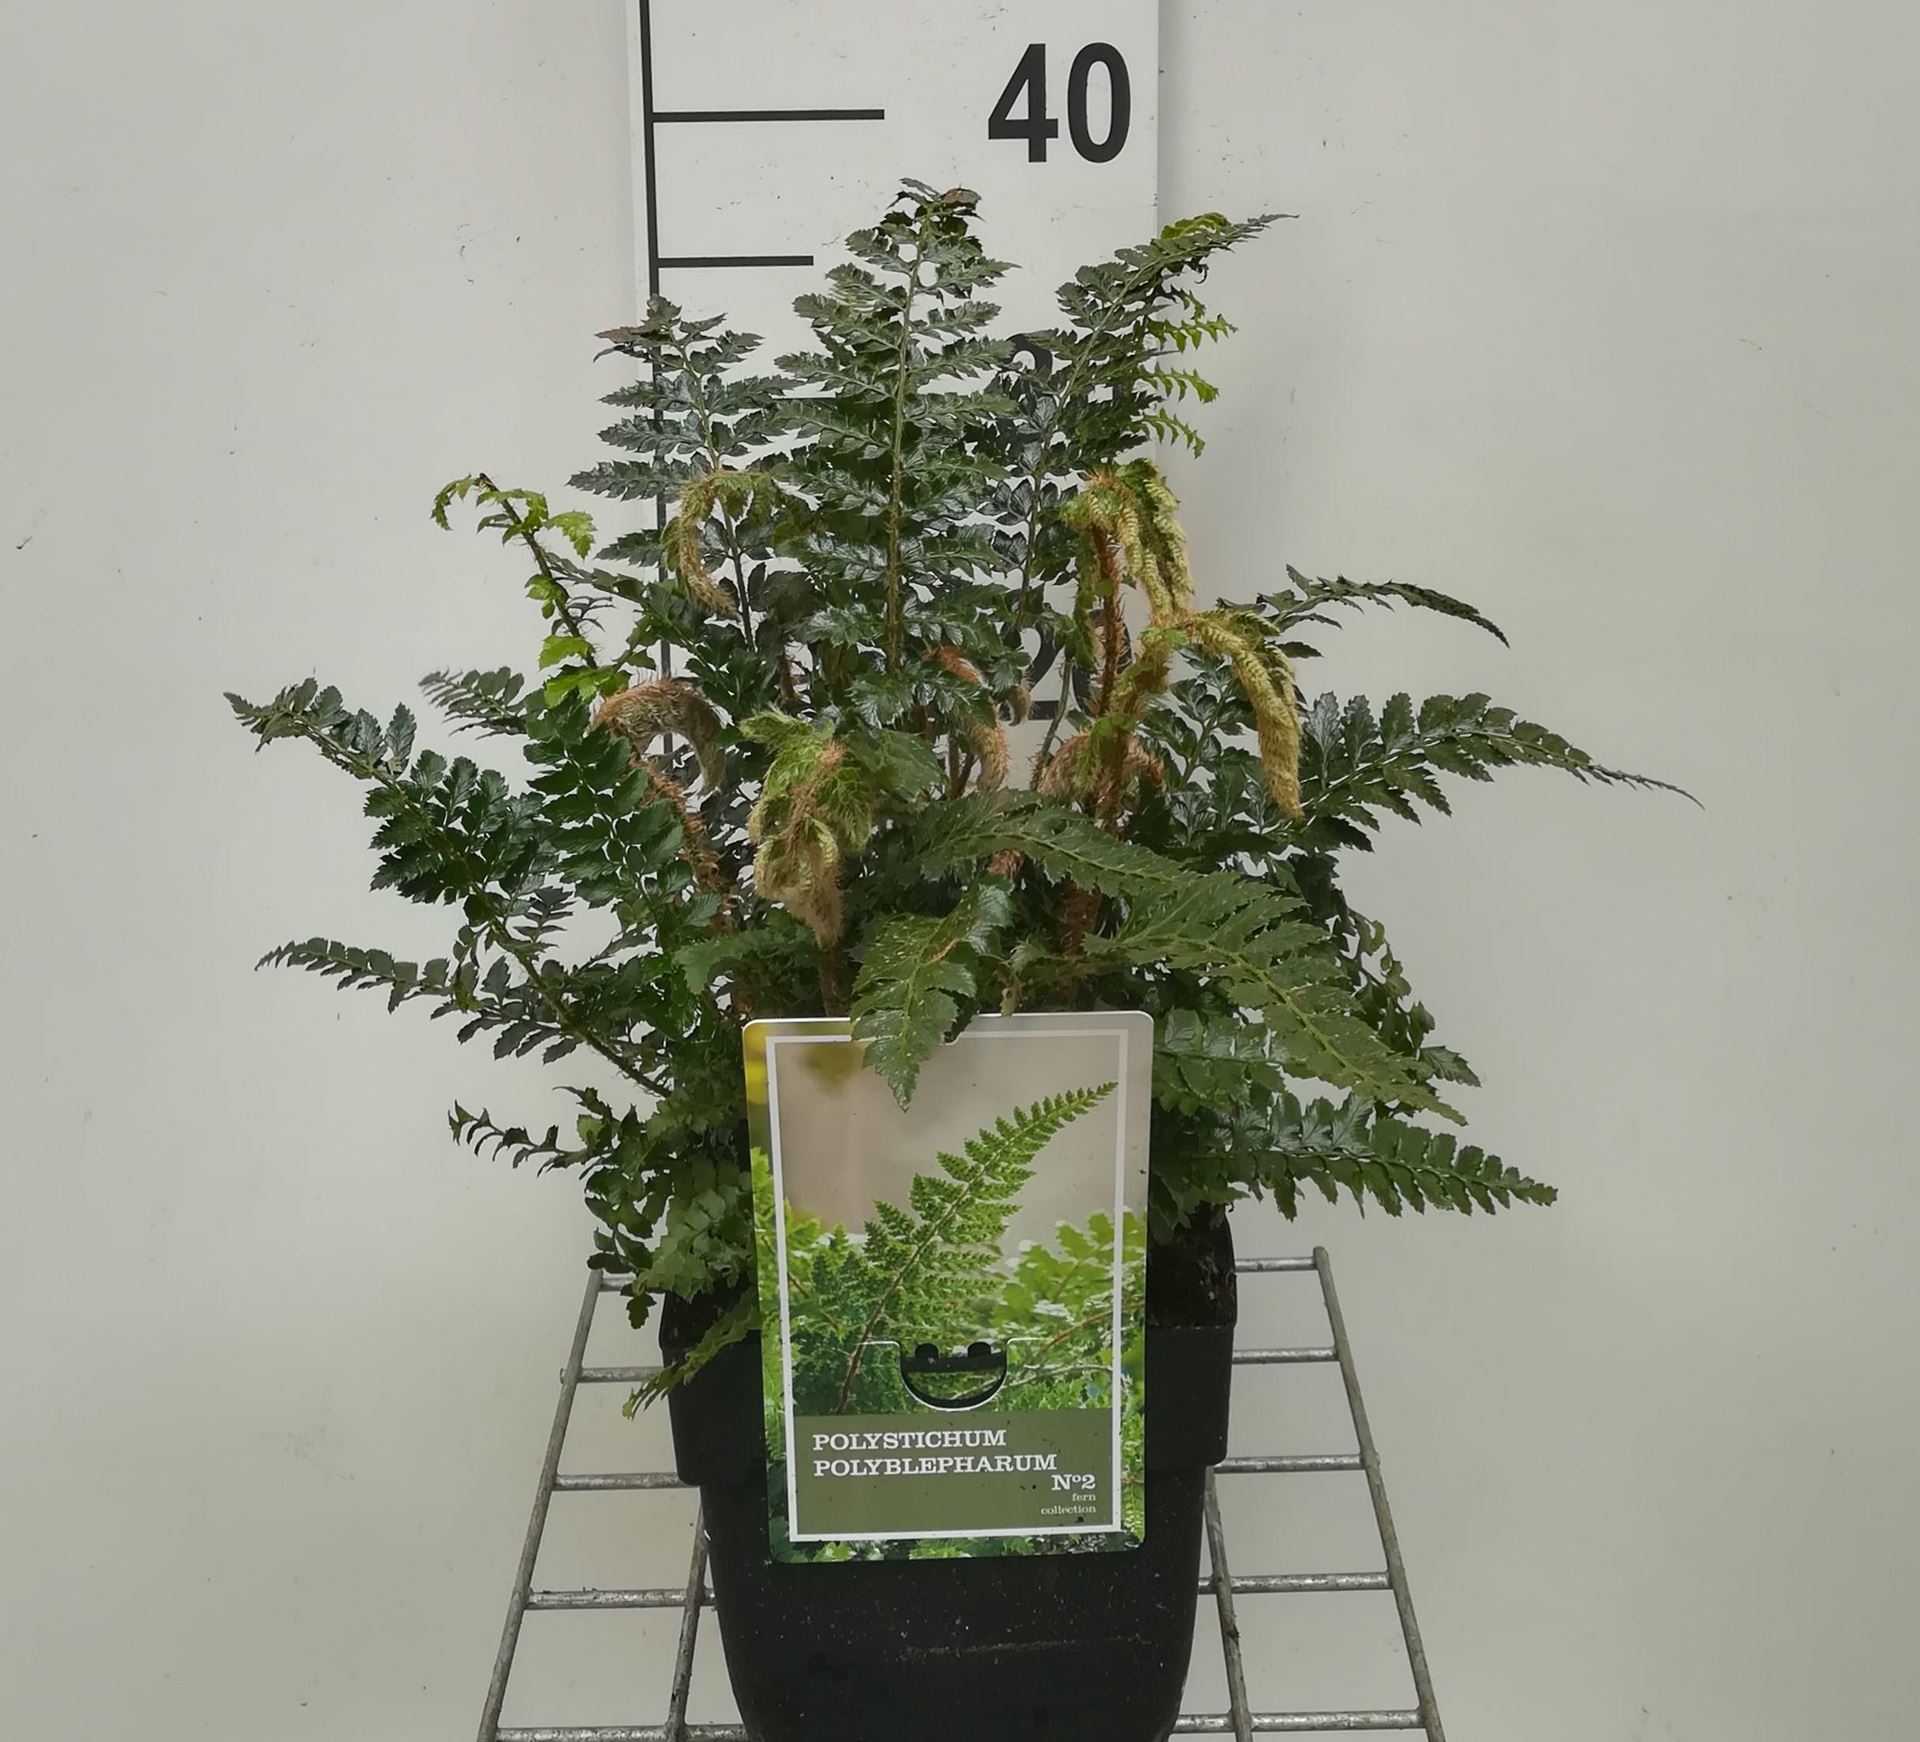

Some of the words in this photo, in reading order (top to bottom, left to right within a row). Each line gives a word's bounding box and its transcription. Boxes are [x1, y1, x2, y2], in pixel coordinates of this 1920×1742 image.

[988, 42, 1131, 163] 40
[812, 1429, 1007, 1451] POLYSTICHUM
[813, 1454, 1057, 1477] POLYBLEPHARUM
[1072, 1493, 1096, 1502] fern
[1041, 1504, 1096, 1515] collection
